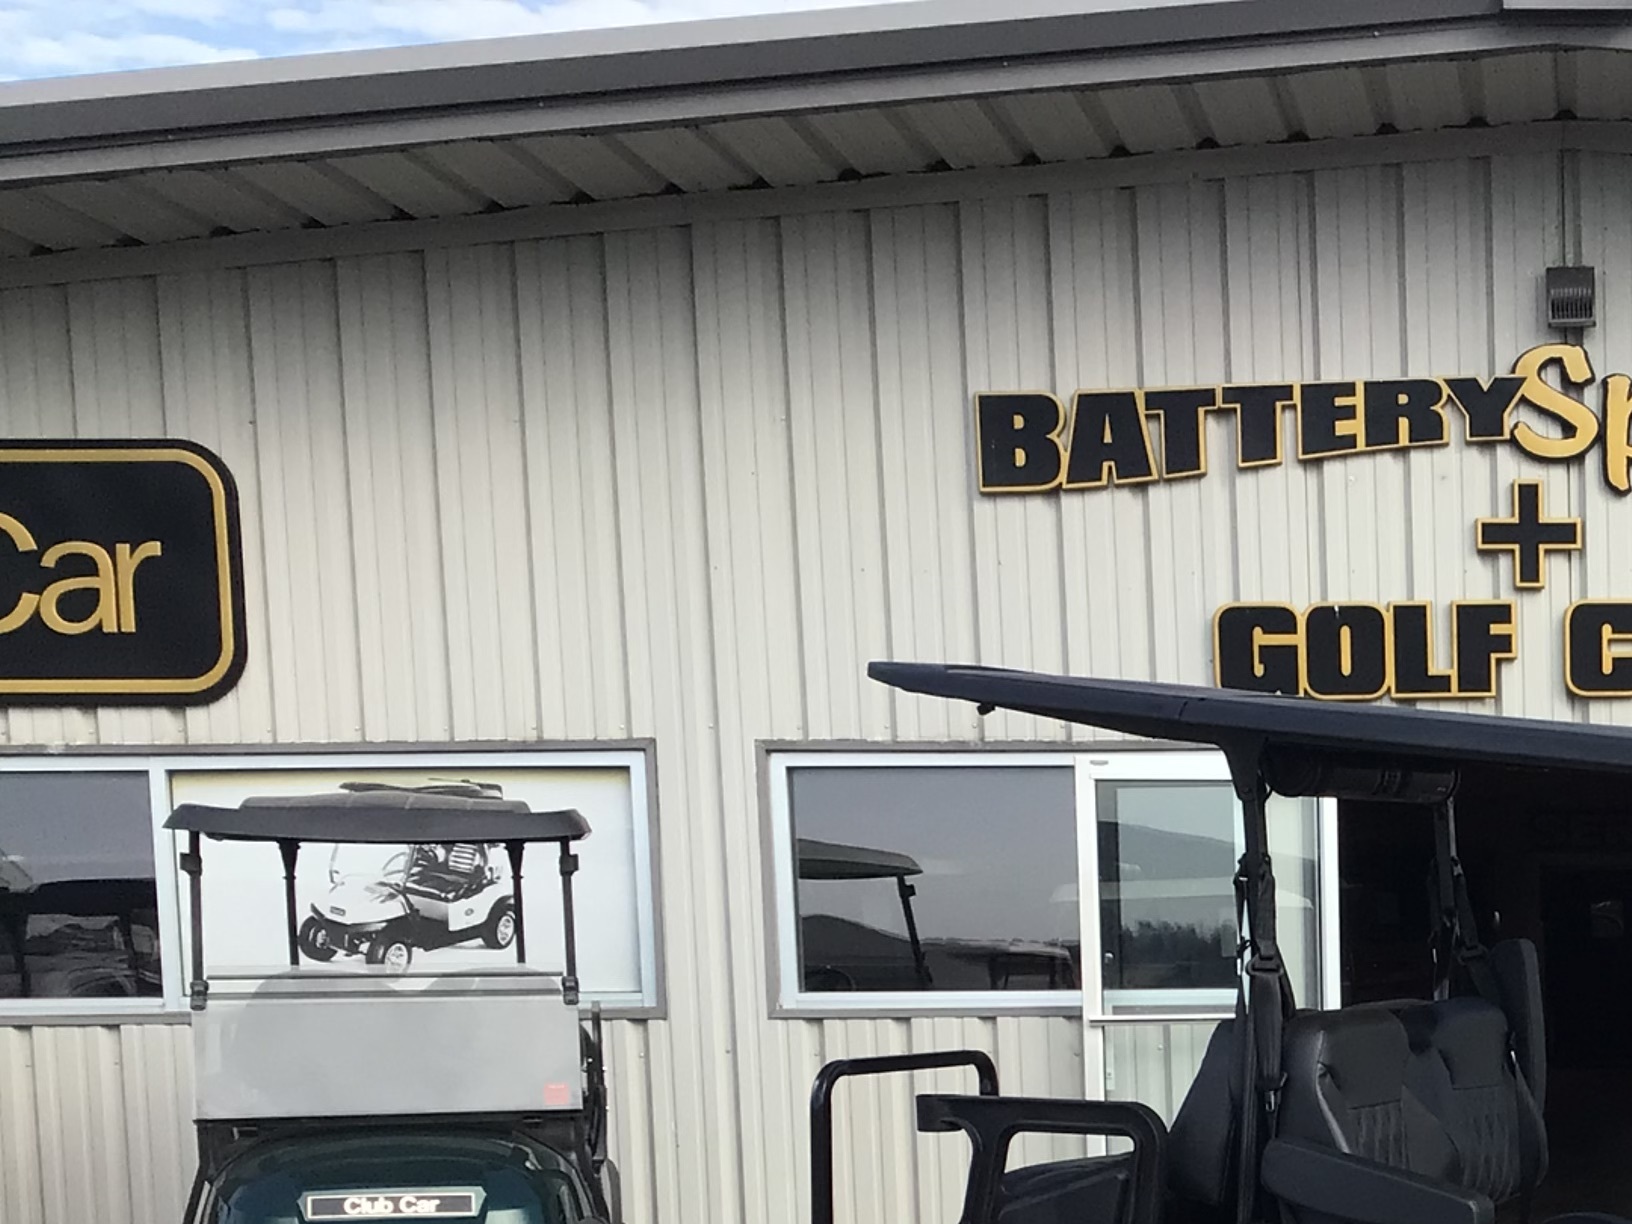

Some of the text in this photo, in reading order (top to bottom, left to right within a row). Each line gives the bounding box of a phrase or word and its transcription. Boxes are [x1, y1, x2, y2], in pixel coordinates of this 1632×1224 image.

[974, 375, 1528, 494] BATTERY
[1214, 600, 1519, 699] GOLF
[343, 1195, 441, 1215] Club Car
